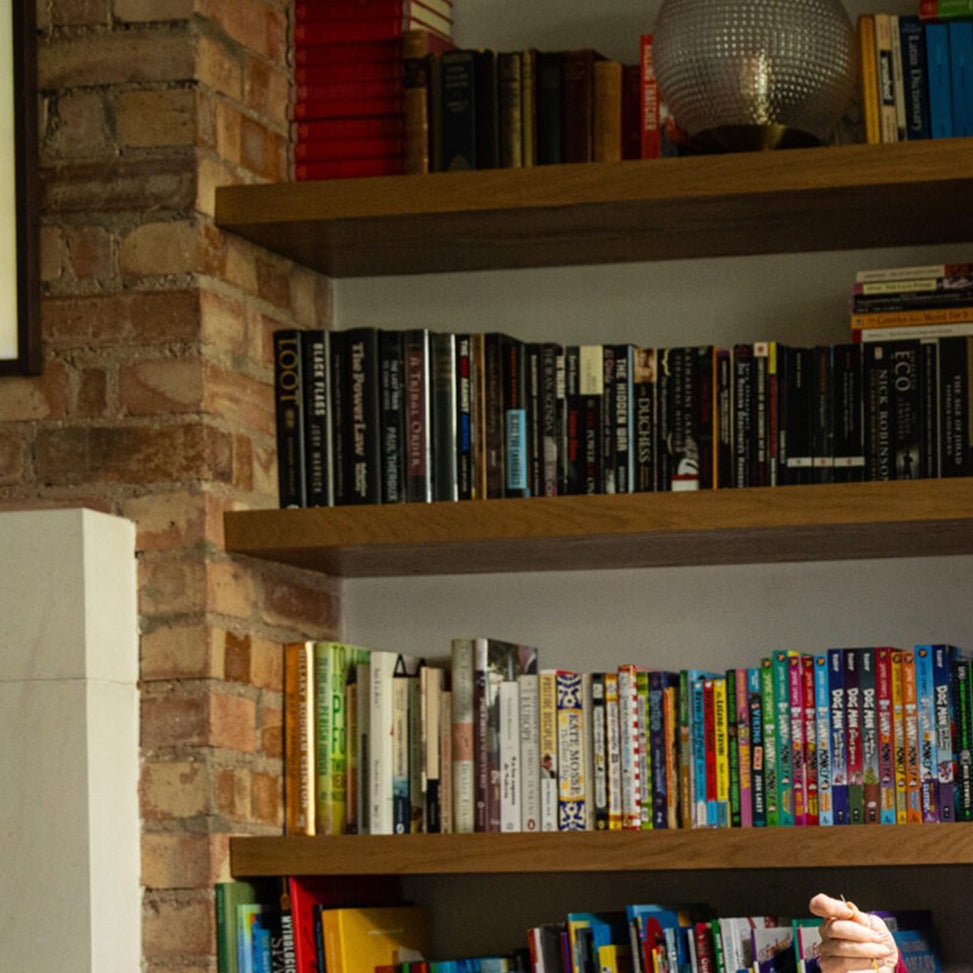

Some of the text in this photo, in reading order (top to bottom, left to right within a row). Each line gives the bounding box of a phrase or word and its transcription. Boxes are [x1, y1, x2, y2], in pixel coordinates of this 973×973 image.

[644, 83, 657, 132] THATCHER
[279, 339, 300, 406] LOOT
[411, 357, 421, 367] A
[894, 350, 911, 392] ECO
[313, 343, 326, 416] BLACK FLAGS
[879, 369, 889, 405] NICK
[953, 374, 962, 395] THE
[352, 341, 367, 457] The Power Law
[616, 358, 628, 452] THE HIDDEN WAR
[954, 397, 962, 417] AGE
[638, 397, 651, 464] DUCHESS
[386, 427, 399, 502] PAUL THEROUX
[298, 649, 306, 697] HILLARY
[832, 688, 844, 709] DOG
[847, 688, 859, 709] DOG
[863, 688, 875, 709] DOG
[936, 685, 949, 725] DOG MAN
[521, 696, 532, 743] EUROPE
[752, 708, 761, 744] VIKING
[832, 709, 844, 729] MAN
[848, 709, 859, 728] MAN
[864, 709, 875, 729] MAN
[569, 714, 581, 796] KATE MOSSE
[780, 745, 790, 774] MONKEY
[820, 749, 830, 779] MONKEY
[881, 743, 892, 773] MONKEY
[922, 740, 933, 770] MONKEY
[300, 755, 308, 808] CLINTON
[754, 774, 762, 791] JOSH
[755, 792, 763, 813] LACEY
